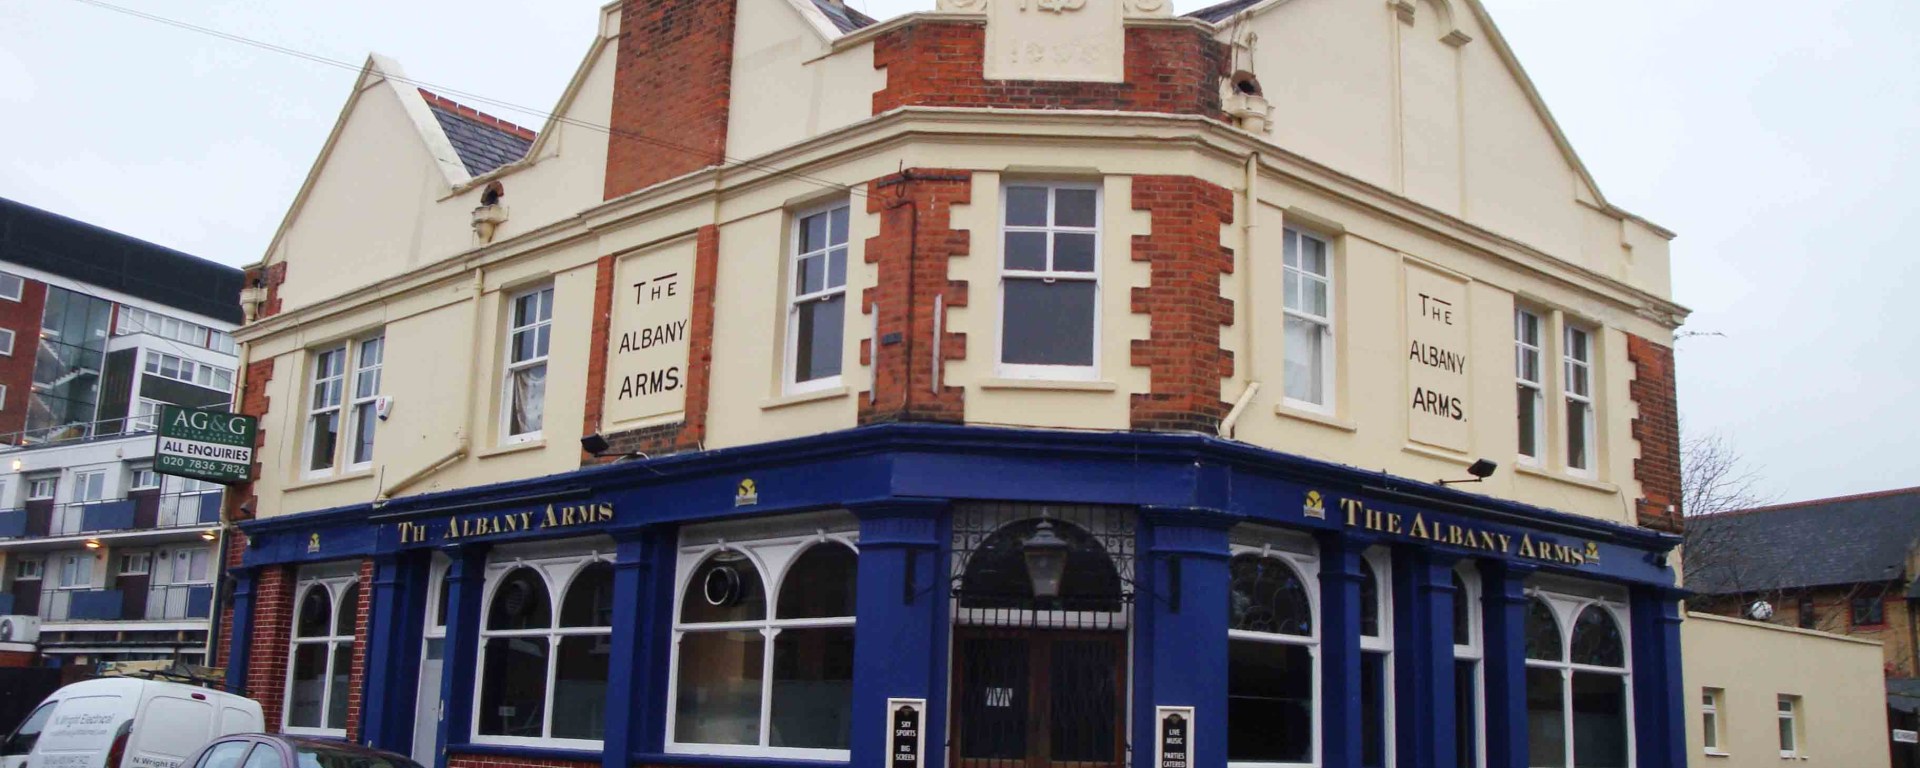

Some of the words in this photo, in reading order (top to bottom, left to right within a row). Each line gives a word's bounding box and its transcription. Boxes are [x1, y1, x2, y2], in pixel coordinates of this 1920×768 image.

[633, 276, 677, 304] THE
[1418, 293, 1453, 325] THE
[619, 319, 687, 354] ALBANY
[1409, 340, 1465, 375] ALBANY
[618, 366, 684, 400] ARMS.
[173, 409, 246, 434] AG&G
[1412, 387, 1467, 422] ARMS.
[163, 440, 184, 453] ALL
[187, 444, 248, 461] ENQUIRIES
[163, 456, 184, 466] 020
[189, 459, 215, 470] 7836
[220, 463, 246, 474] 7826
[443, 515, 533, 539] ALBANY
[540, 503, 614, 528] ARMS
[1340, 498, 1401, 534] THE
[1409, 512, 1511, 552] ALBANY
[1518, 533, 1586, 565] ARMS
